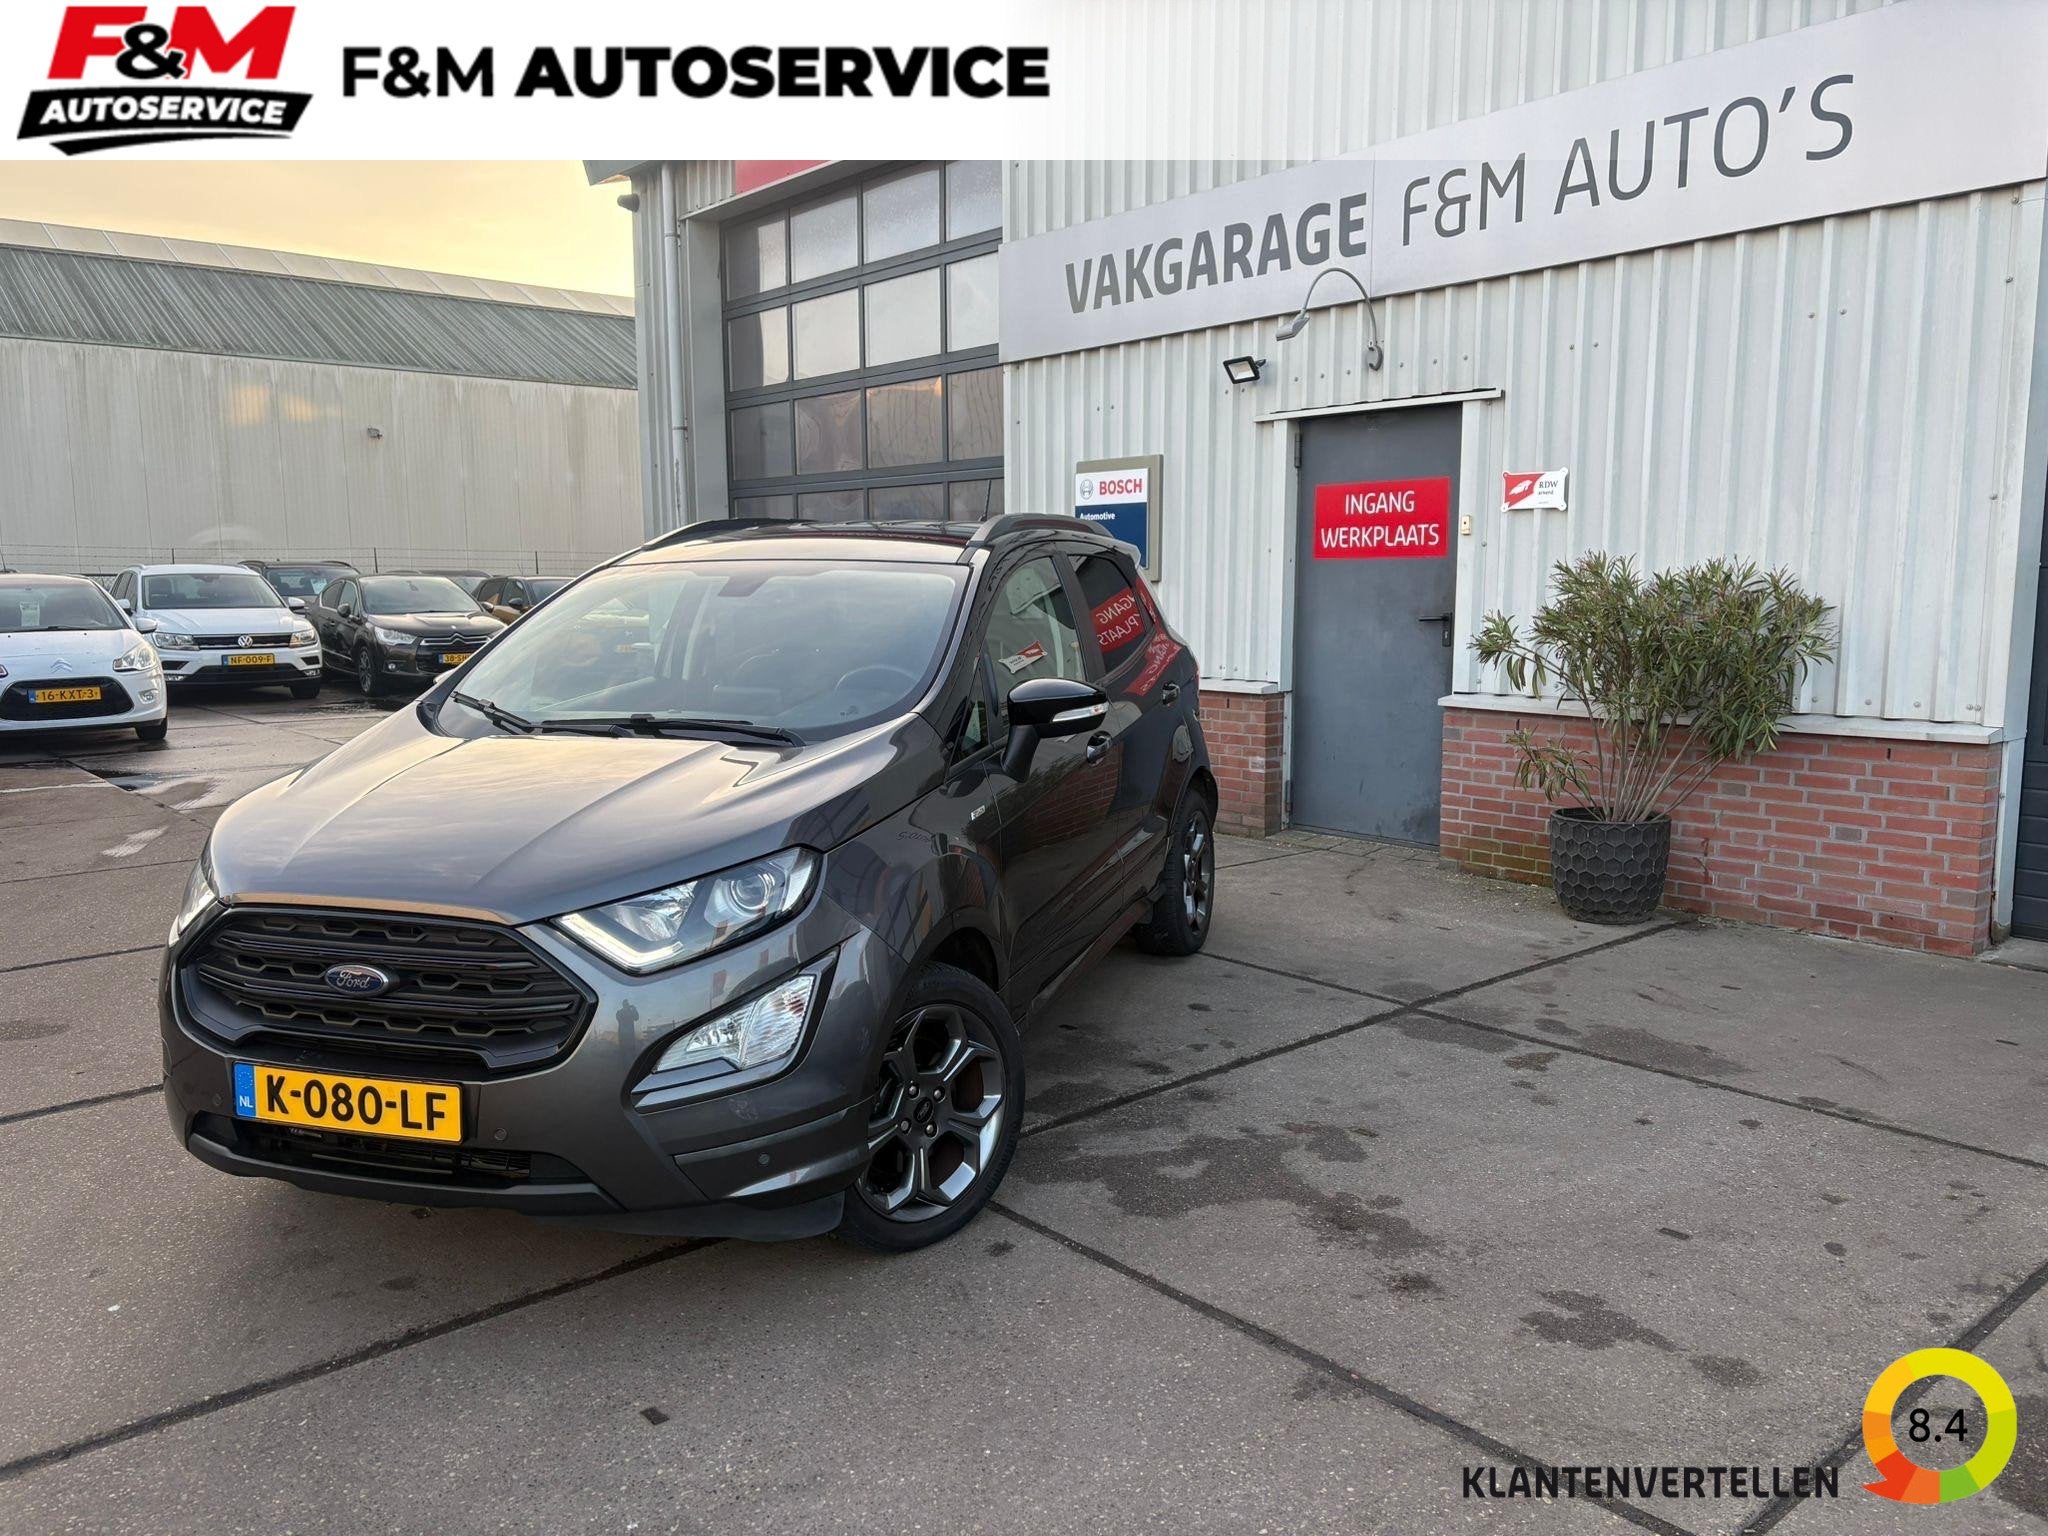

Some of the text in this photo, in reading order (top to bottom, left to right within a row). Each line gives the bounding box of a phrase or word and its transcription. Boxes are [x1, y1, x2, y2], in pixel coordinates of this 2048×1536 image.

[1065, 74, 1854, 314] VAKGARAGE F&M AUTO'S
[1099, 478, 1143, 495] BOSCH
[1538, 480, 1559, 489] RDW
[1345, 490, 1415, 516] INGANG
[1080, 511, 1115, 520] Automotive
[1320, 523, 1440, 549] WERKPLAATS
[41, 689, 94, 701] 16-KXT-3
[337, 969, 372, 990] Ford
[239, 1095, 254, 1109] NL
[266, 1074, 447, 1132] K-080-LF
